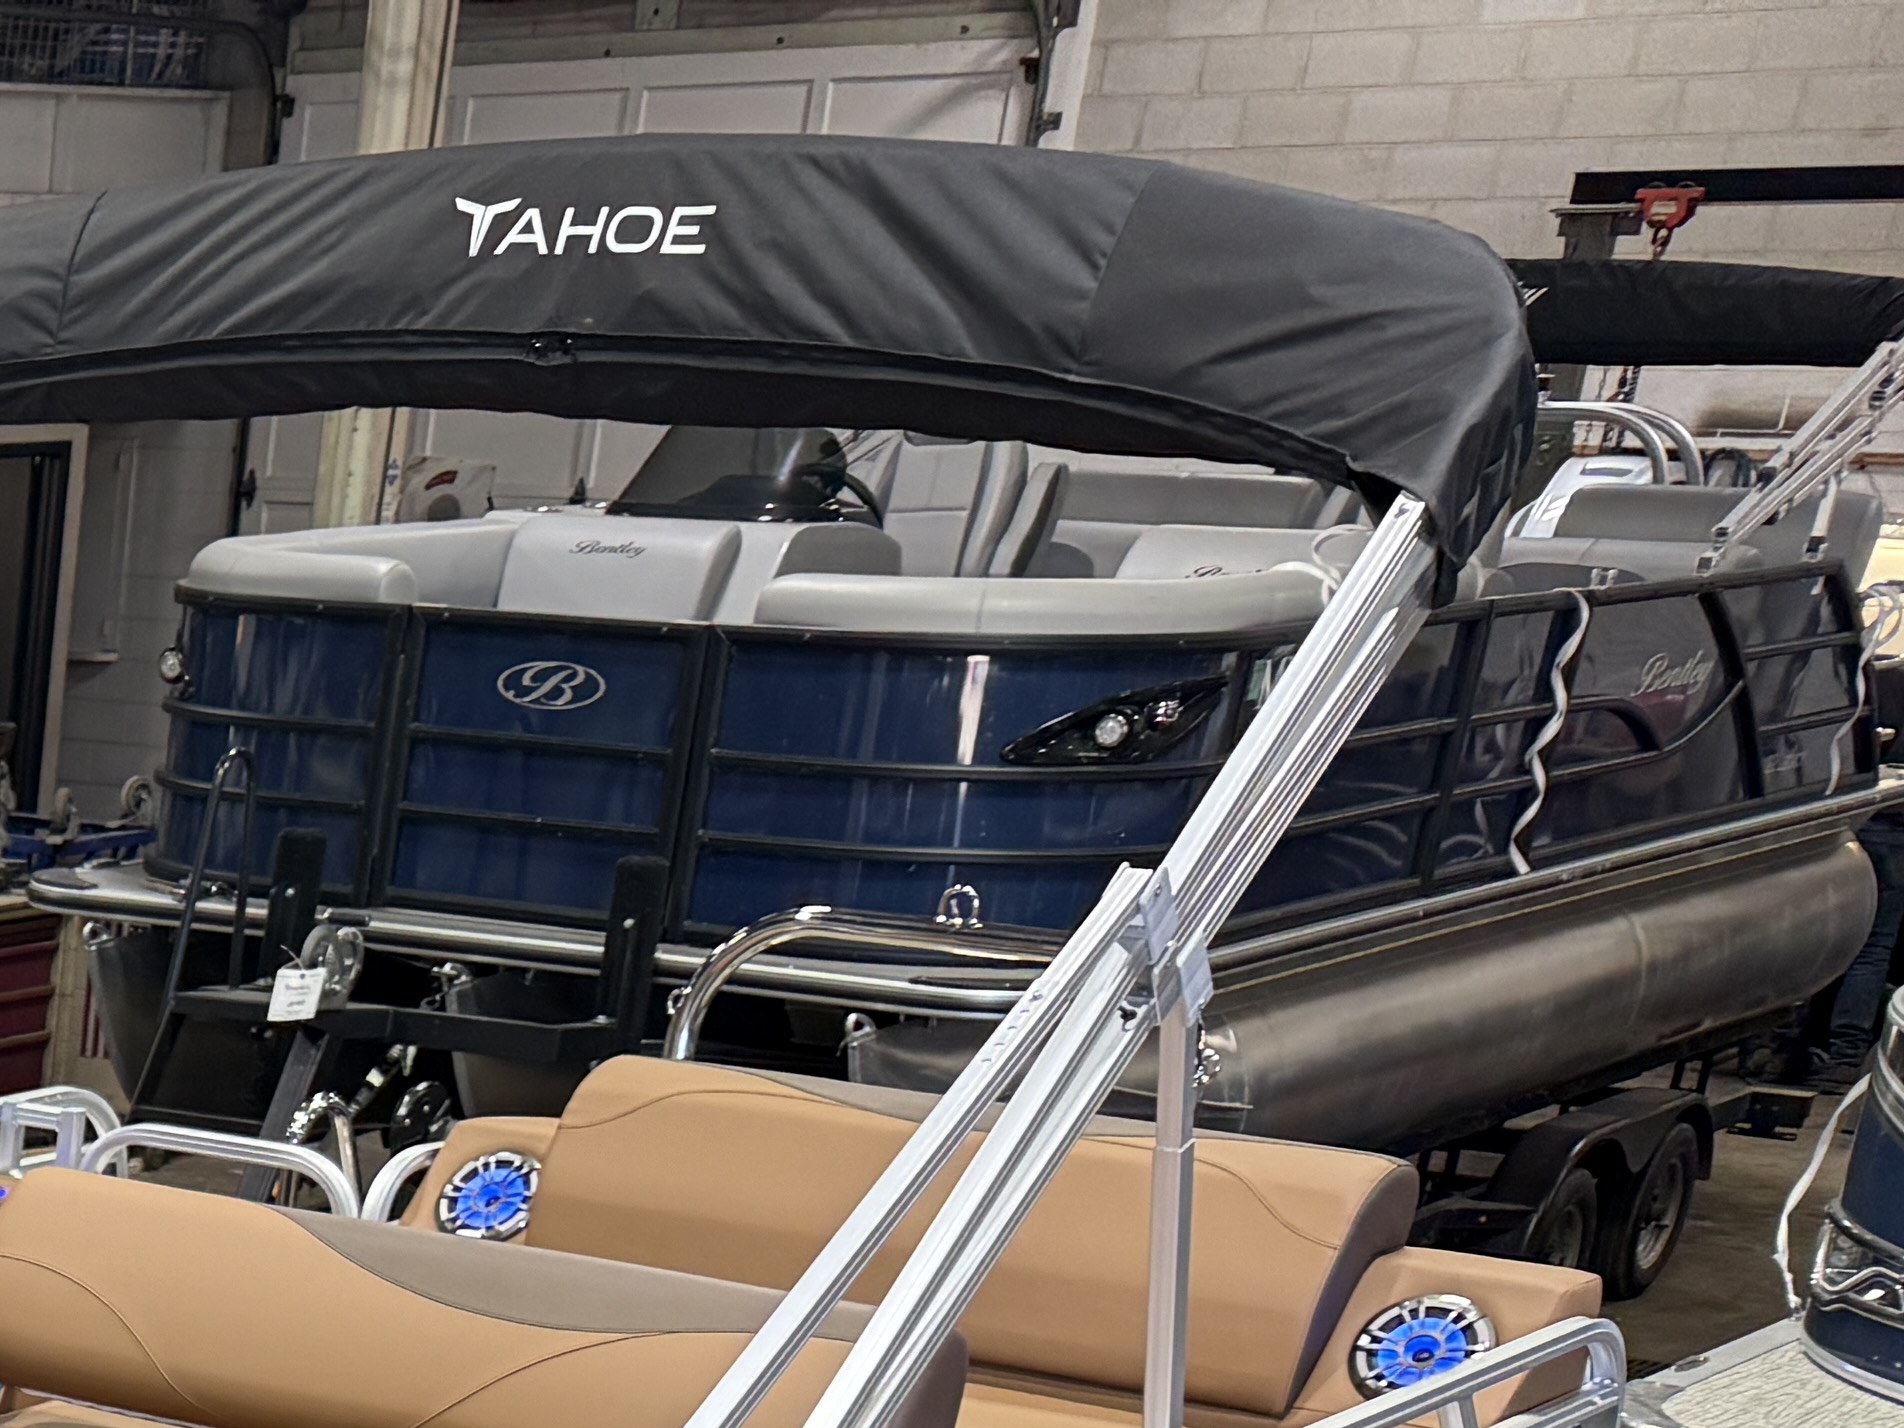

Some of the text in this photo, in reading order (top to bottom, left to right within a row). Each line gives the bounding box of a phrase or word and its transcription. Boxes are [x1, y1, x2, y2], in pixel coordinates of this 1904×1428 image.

[455, 197, 717, 257] TAHOE
[569, 540, 646, 558] Bentley
[1630, 650, 1715, 696] Bentley
